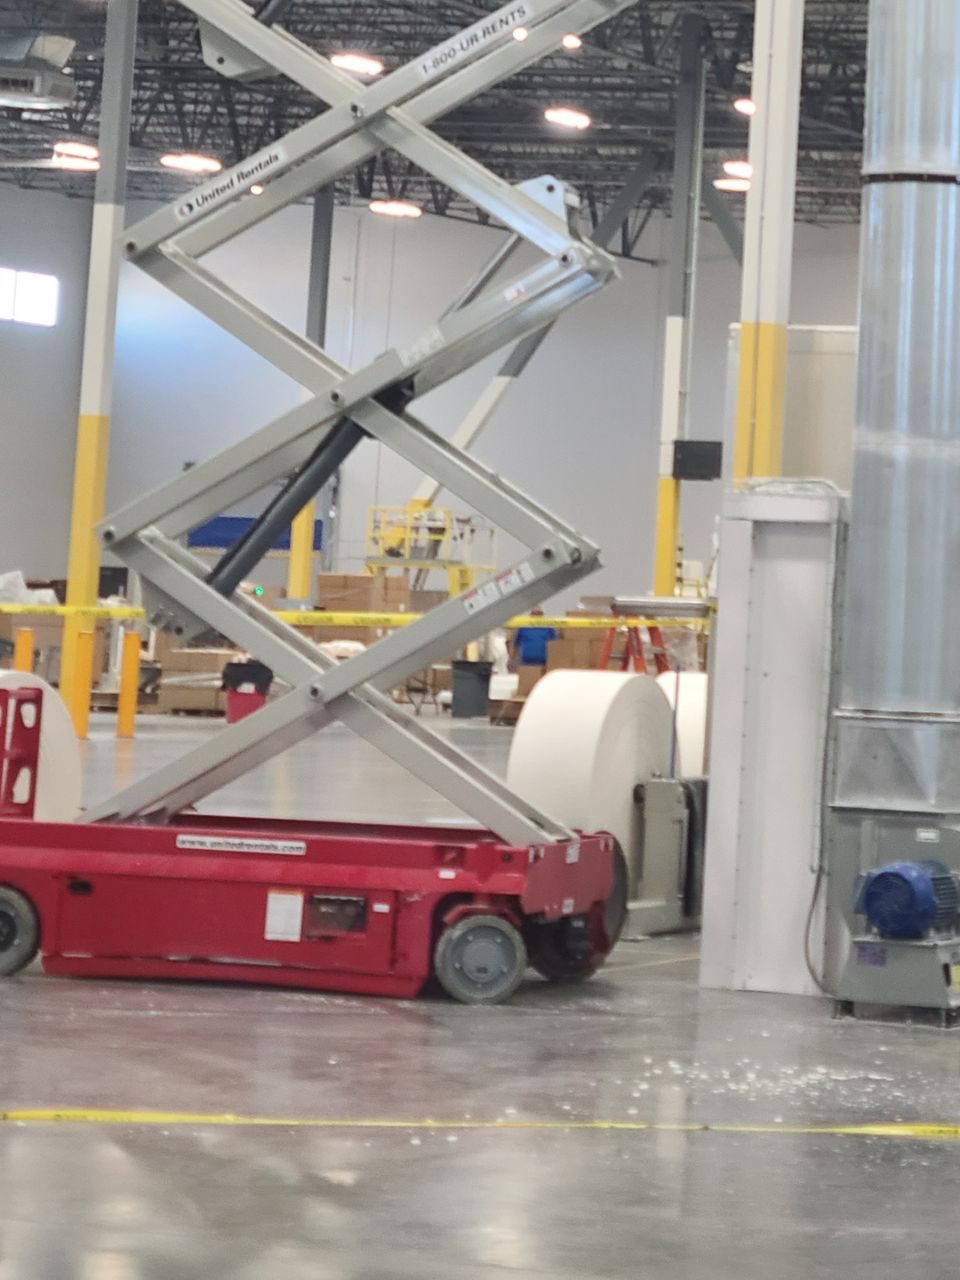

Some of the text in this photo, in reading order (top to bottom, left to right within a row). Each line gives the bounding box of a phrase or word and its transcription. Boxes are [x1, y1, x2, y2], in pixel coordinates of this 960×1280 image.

[422, 5, 526, 74] 1-800-UR-RENTS
[195, 154, 280, 208] United Rentals
